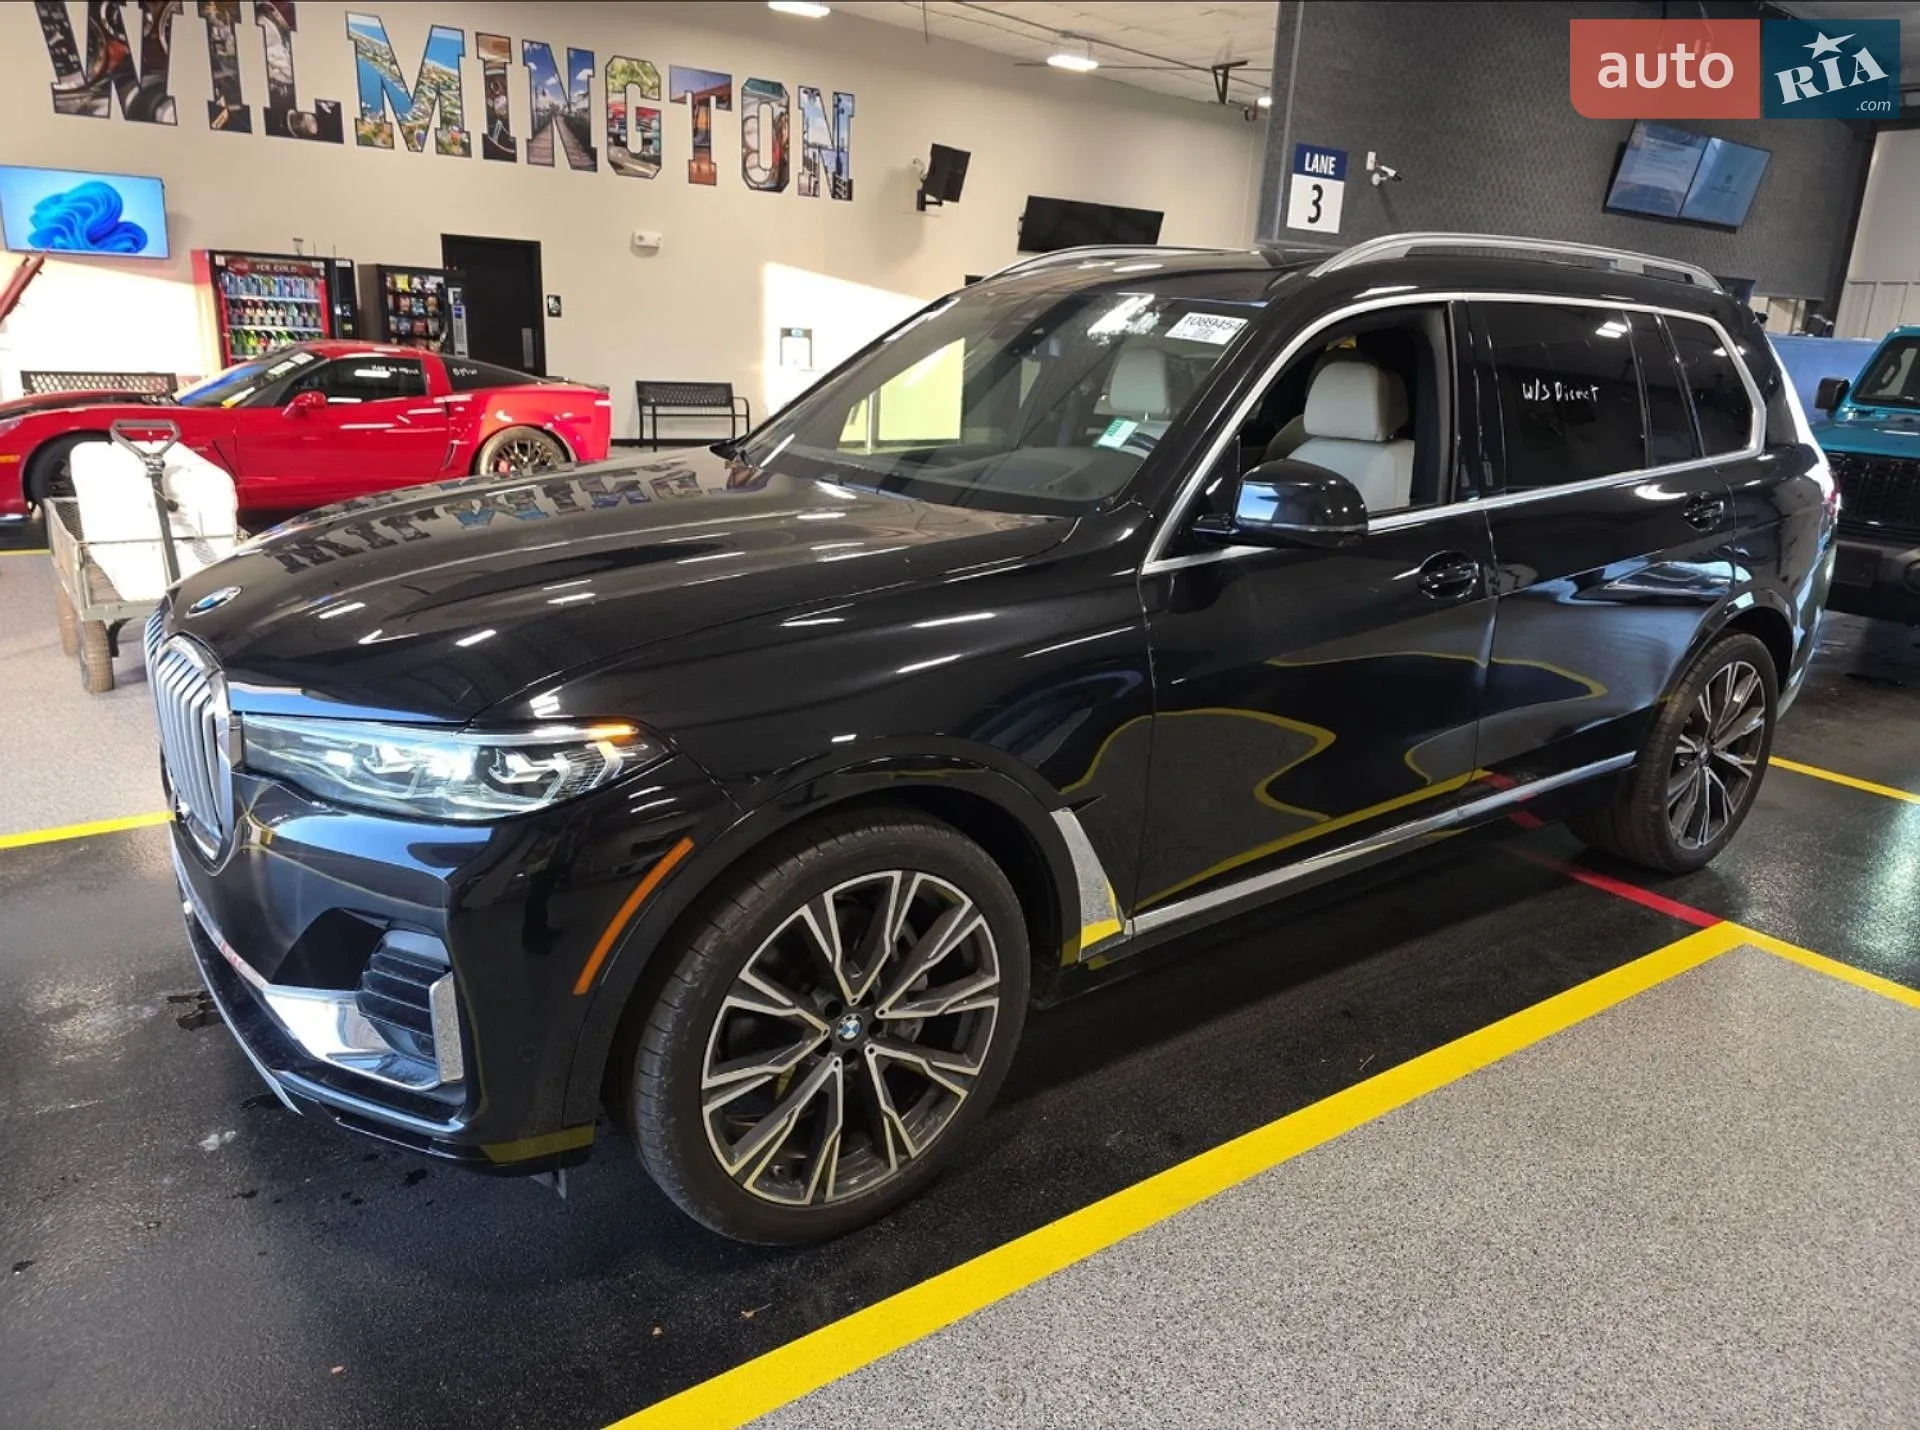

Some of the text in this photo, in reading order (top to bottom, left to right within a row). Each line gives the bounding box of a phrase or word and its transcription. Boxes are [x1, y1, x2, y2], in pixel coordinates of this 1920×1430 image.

[35, 2, 855, 201] WILMINGTON
[1304, 152, 1337, 176] LANE
[1307, 183, 1324, 224] 3
